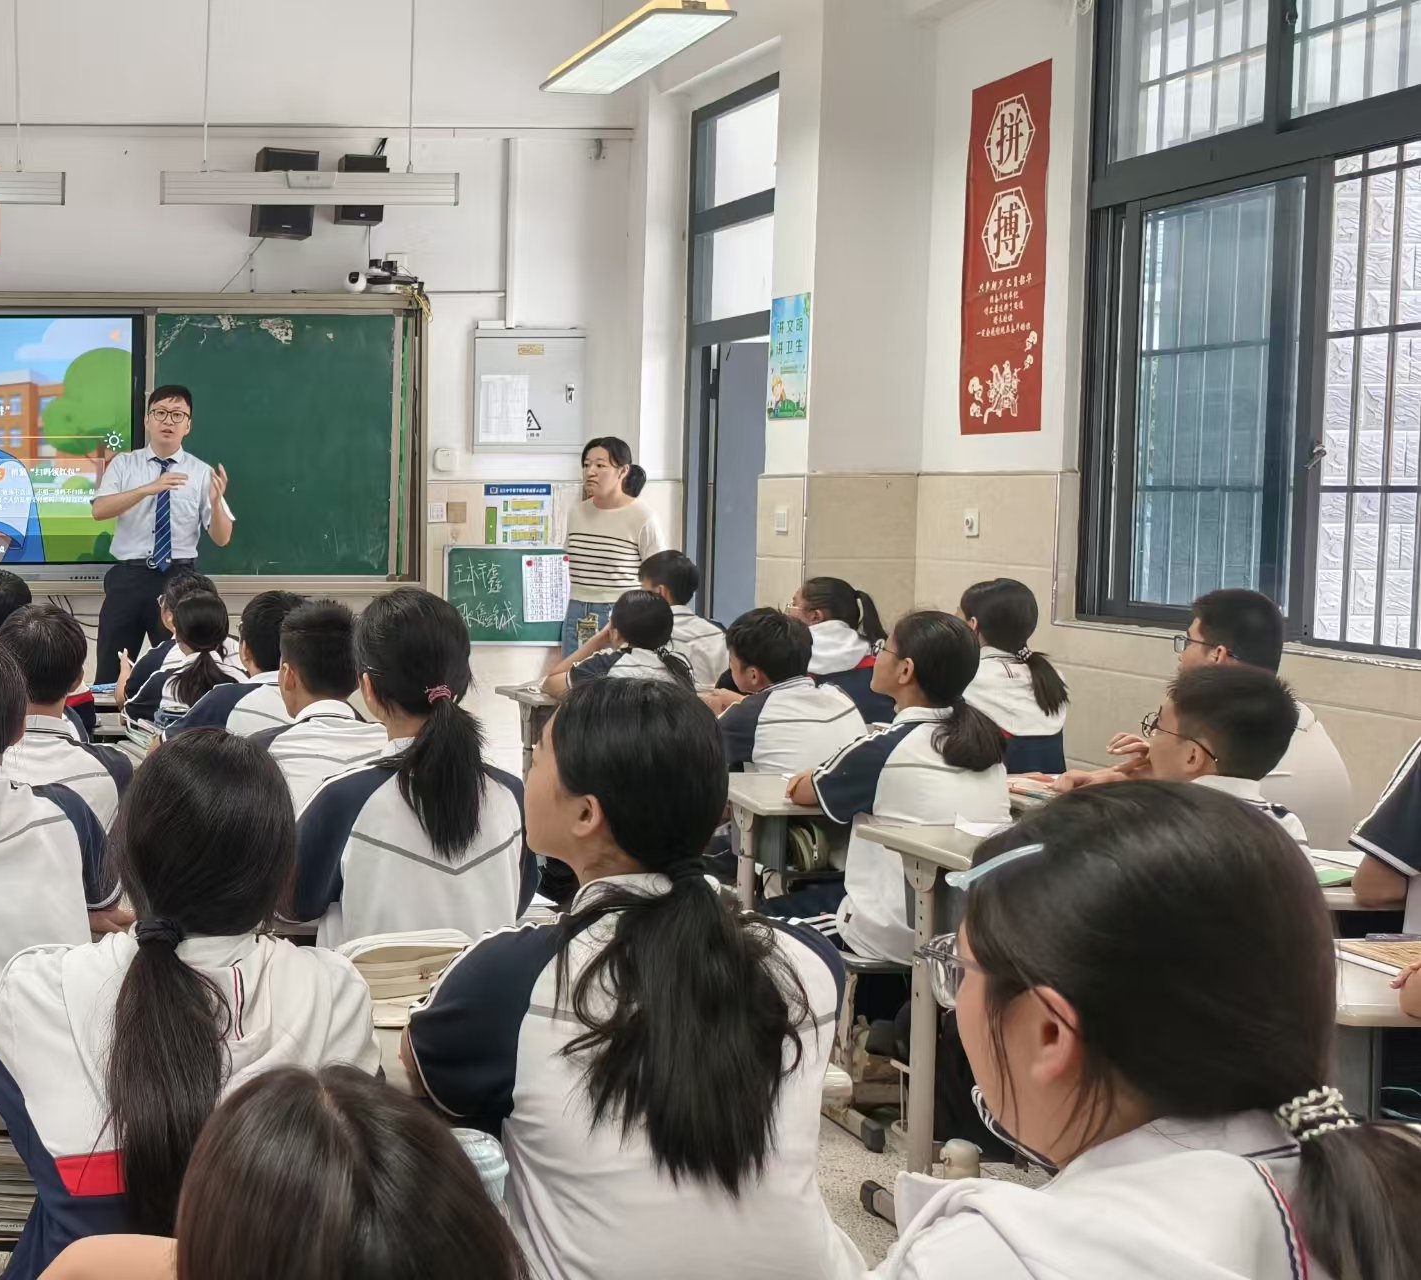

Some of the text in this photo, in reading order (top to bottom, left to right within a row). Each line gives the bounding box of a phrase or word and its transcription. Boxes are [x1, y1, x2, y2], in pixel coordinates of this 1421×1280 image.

[777, 317, 803, 335] 讲文明
[776, 338, 803, 355] 讲卫生
